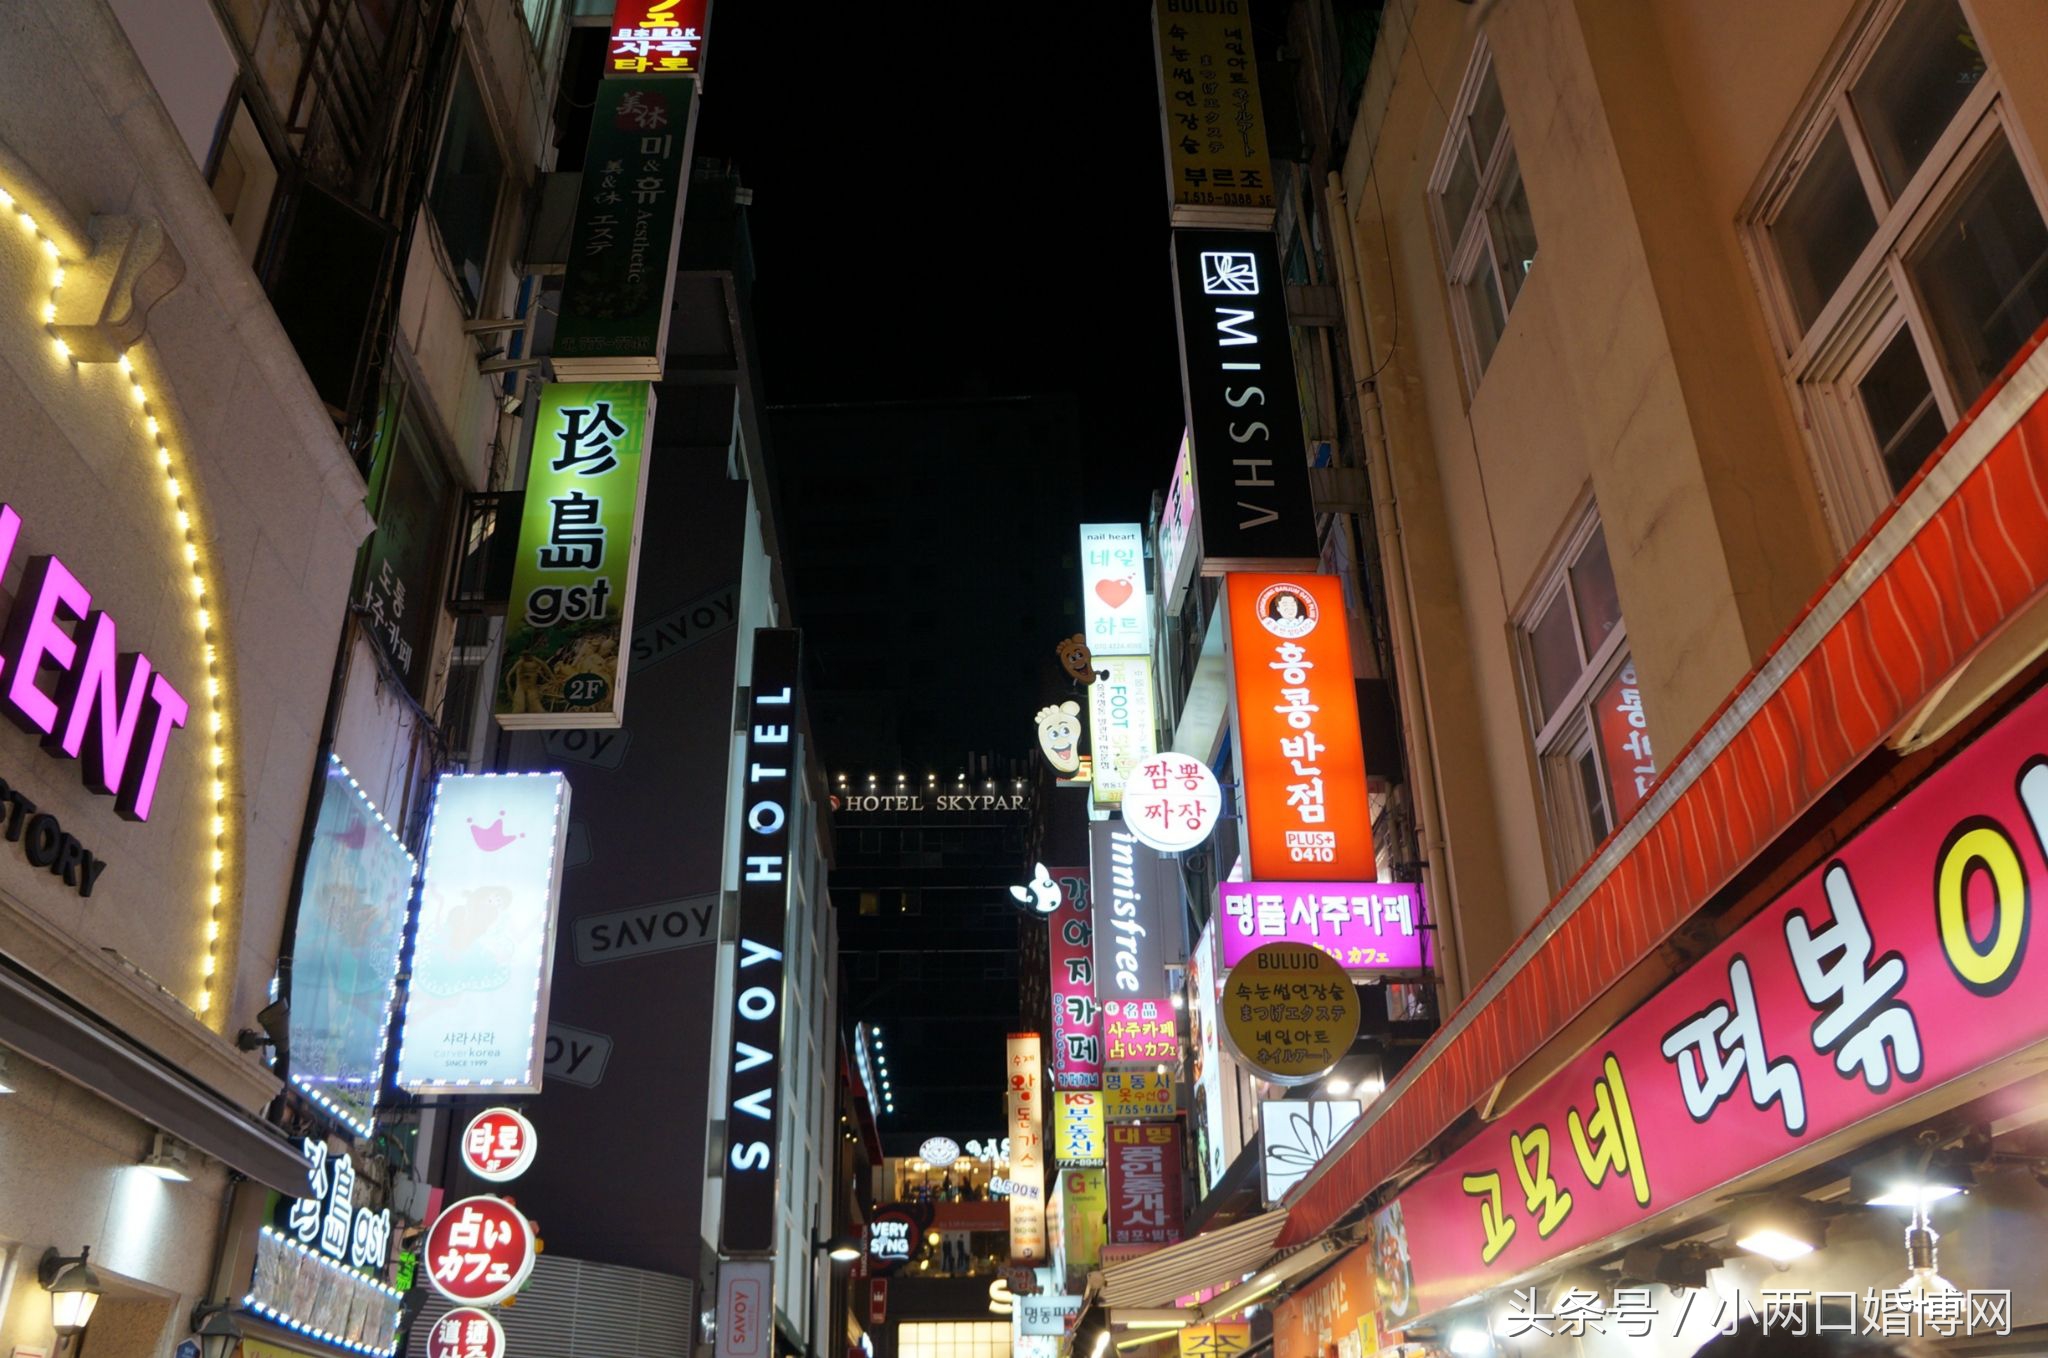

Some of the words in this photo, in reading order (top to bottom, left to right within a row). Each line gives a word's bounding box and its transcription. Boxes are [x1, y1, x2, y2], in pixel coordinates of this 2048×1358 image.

[612, 40, 697, 57] 사주
[614, 57, 695, 73] 타로
[1185, 168, 1263, 188] 부르조
[1215, 307, 1279, 530] MISSHA
[540, 403, 625, 570] 珍島
[1087, 533, 1106, 541] nail
[1109, 533, 1136, 541] heart
[1089, 548, 1136, 567] 네일
[528, 579, 609, 626] gst
[1094, 616, 1142, 637] 하트
[569, 679, 604, 700] 2F
[1110, 685, 1129, 729] FOOT
[1268, 641, 1326, 824] 홍콩반점
[745, 686, 792, 883] HOTEL
[1143, 760, 1205, 790] 짬뽕
[845, 796, 924, 811] HOTEL
[1145, 799, 1207, 830] 짜장
[1287, 832, 1334, 847] PLUS+
[1290, 848, 1334, 863] 0410
[1111, 830, 1146, 991] innisfree
[1225, 893, 1415, 936] 명품사주카페
[590, 904, 714, 954] SAVOY
[1061, 877, 1098, 1064] 강아지카페
[1258, 952, 1319, 970] BULUJO
[1236, 982, 1345, 1001] 속눈썹연장술
[1240, 1003, 1346, 1022] まつげエクステ
[1108, 1020, 1176, 1040] 사주카페
[1256, 1029, 1331, 1045] 네일아트
[730, 937, 783, 1172] SAVOY
[1109, 1039, 1177, 1059] 占いカフェ
[1065, 1093, 1094, 1106] KS
[1011, 1074, 1040, 1169] 왕돈가스
[1063, 1108, 1093, 1157] 부동산
[470, 1122, 520, 1161] 타로
[1463, 1056, 1651, 1264] 고모네
[447, 1207, 512, 1249] 占い
[870, 1221, 910, 1237] VERY
[435, 1249, 511, 1283] カフェ
[733, 1291, 748, 1344] SAVOY
